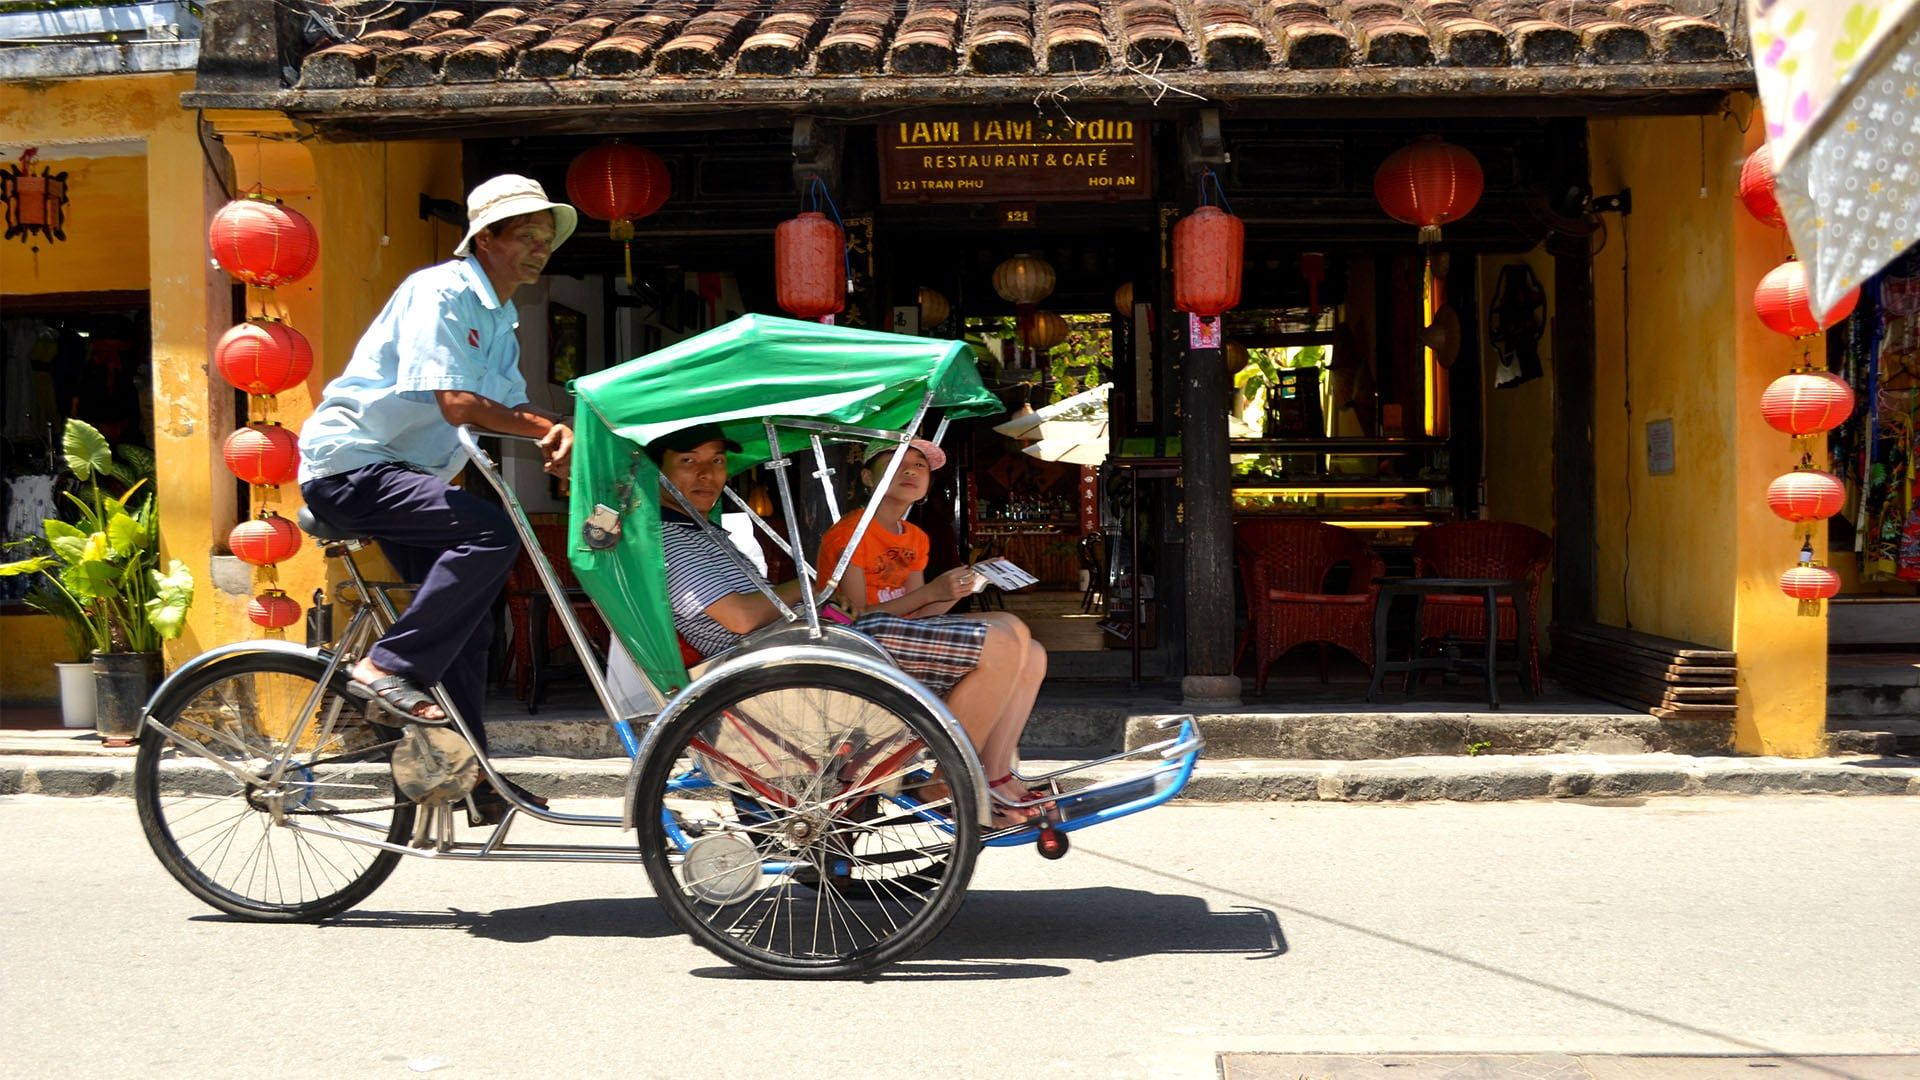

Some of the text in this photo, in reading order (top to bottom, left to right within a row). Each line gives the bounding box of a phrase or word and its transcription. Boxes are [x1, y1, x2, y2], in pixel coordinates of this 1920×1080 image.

[923, 149, 1108, 169] RESTAURANT & CAFÉ
[896, 179, 984, 190] 121 TRAN PHU
[1088, 175, 1135, 187] HOI AN
[1007, 210, 1028, 222] 121
